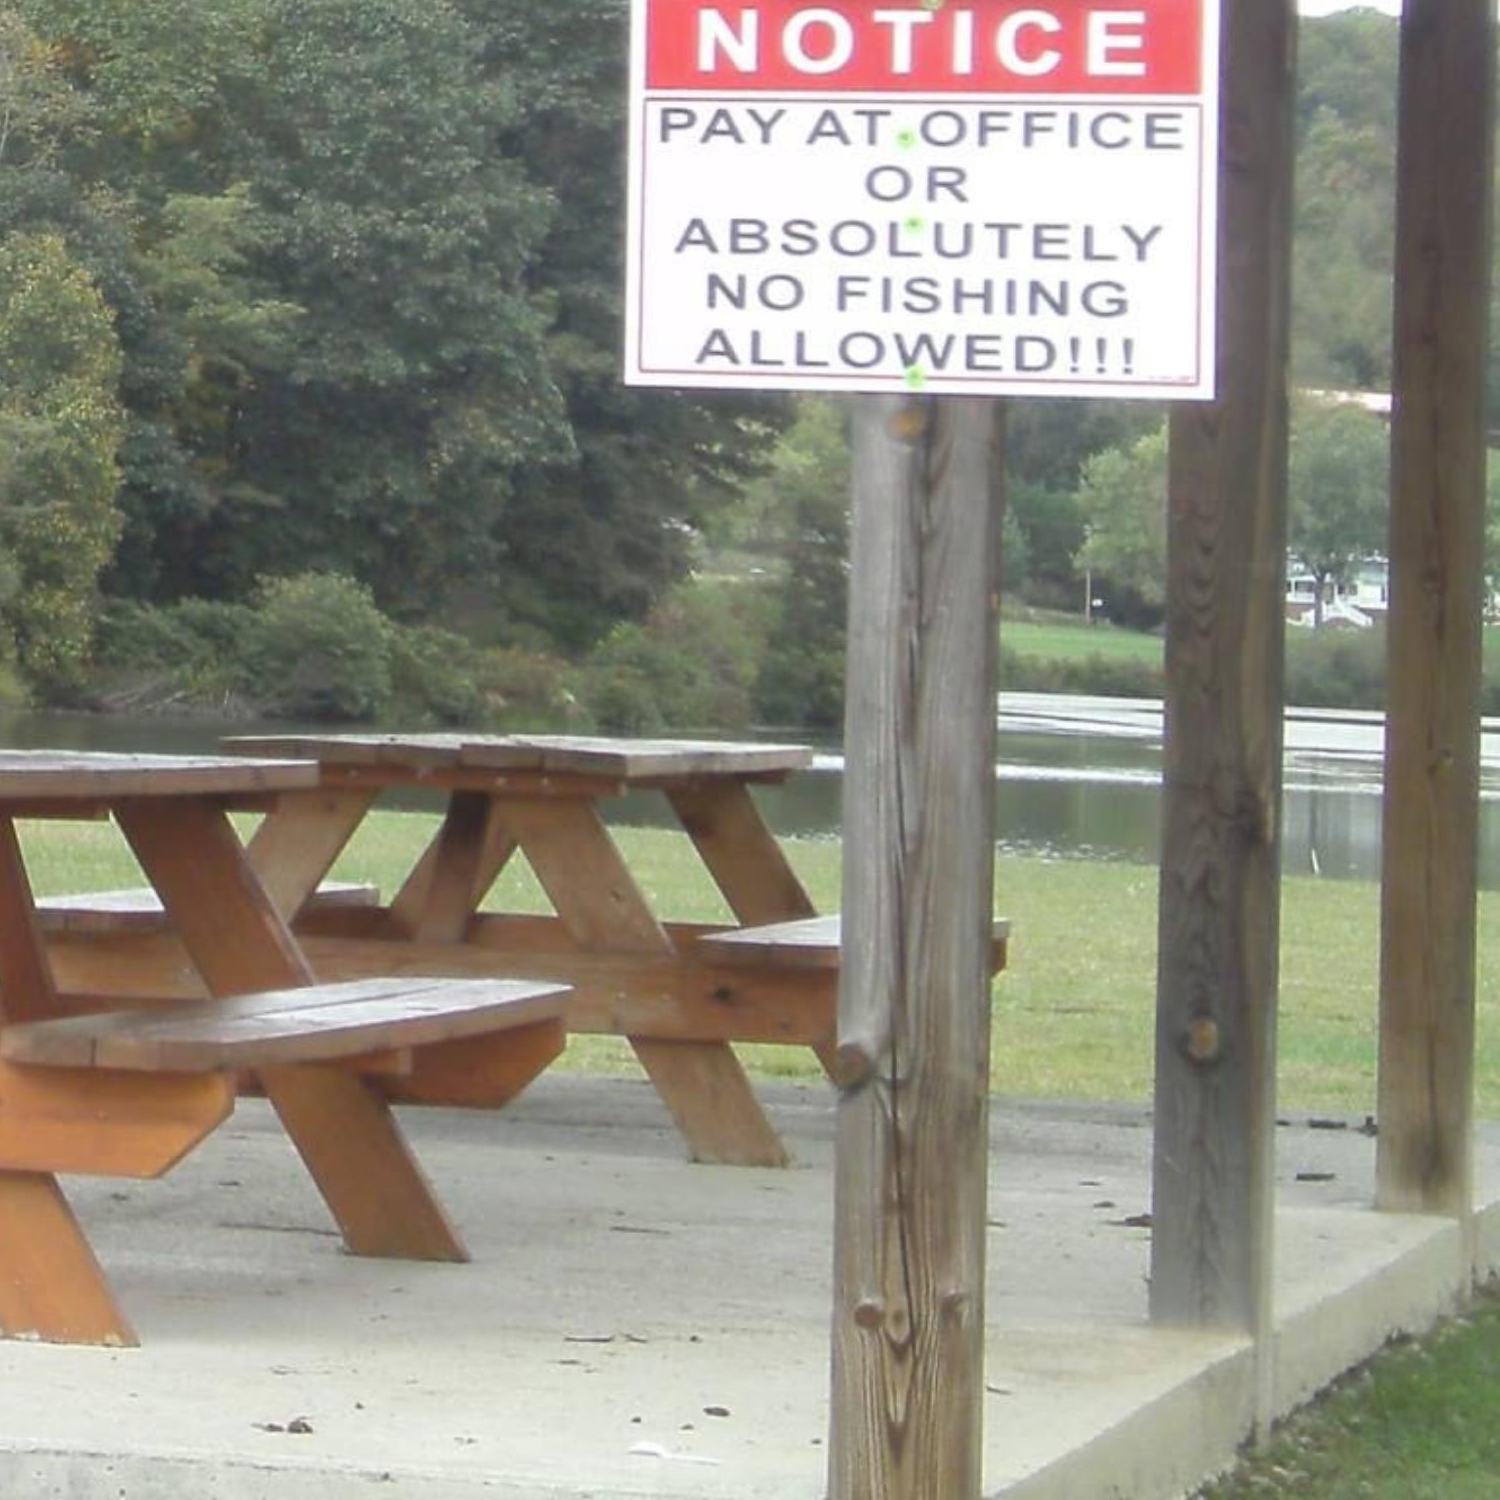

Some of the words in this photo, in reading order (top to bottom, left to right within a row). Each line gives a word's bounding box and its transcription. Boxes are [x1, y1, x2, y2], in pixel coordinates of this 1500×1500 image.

[697, 8, 1148, 77] NOTICE
[659, 108, 788, 146] PAY
[805, 110, 892, 147] AT
[919, 111, 1185, 150] OFFICE
[864, 165, 969, 204] OR
[674, 217, 1163, 262] ABSOLUTELY
[705, 273, 805, 311] NO
[835, 276, 1131, 318] FISHING
[695, 328, 1136, 375] ALLOWED!!!
